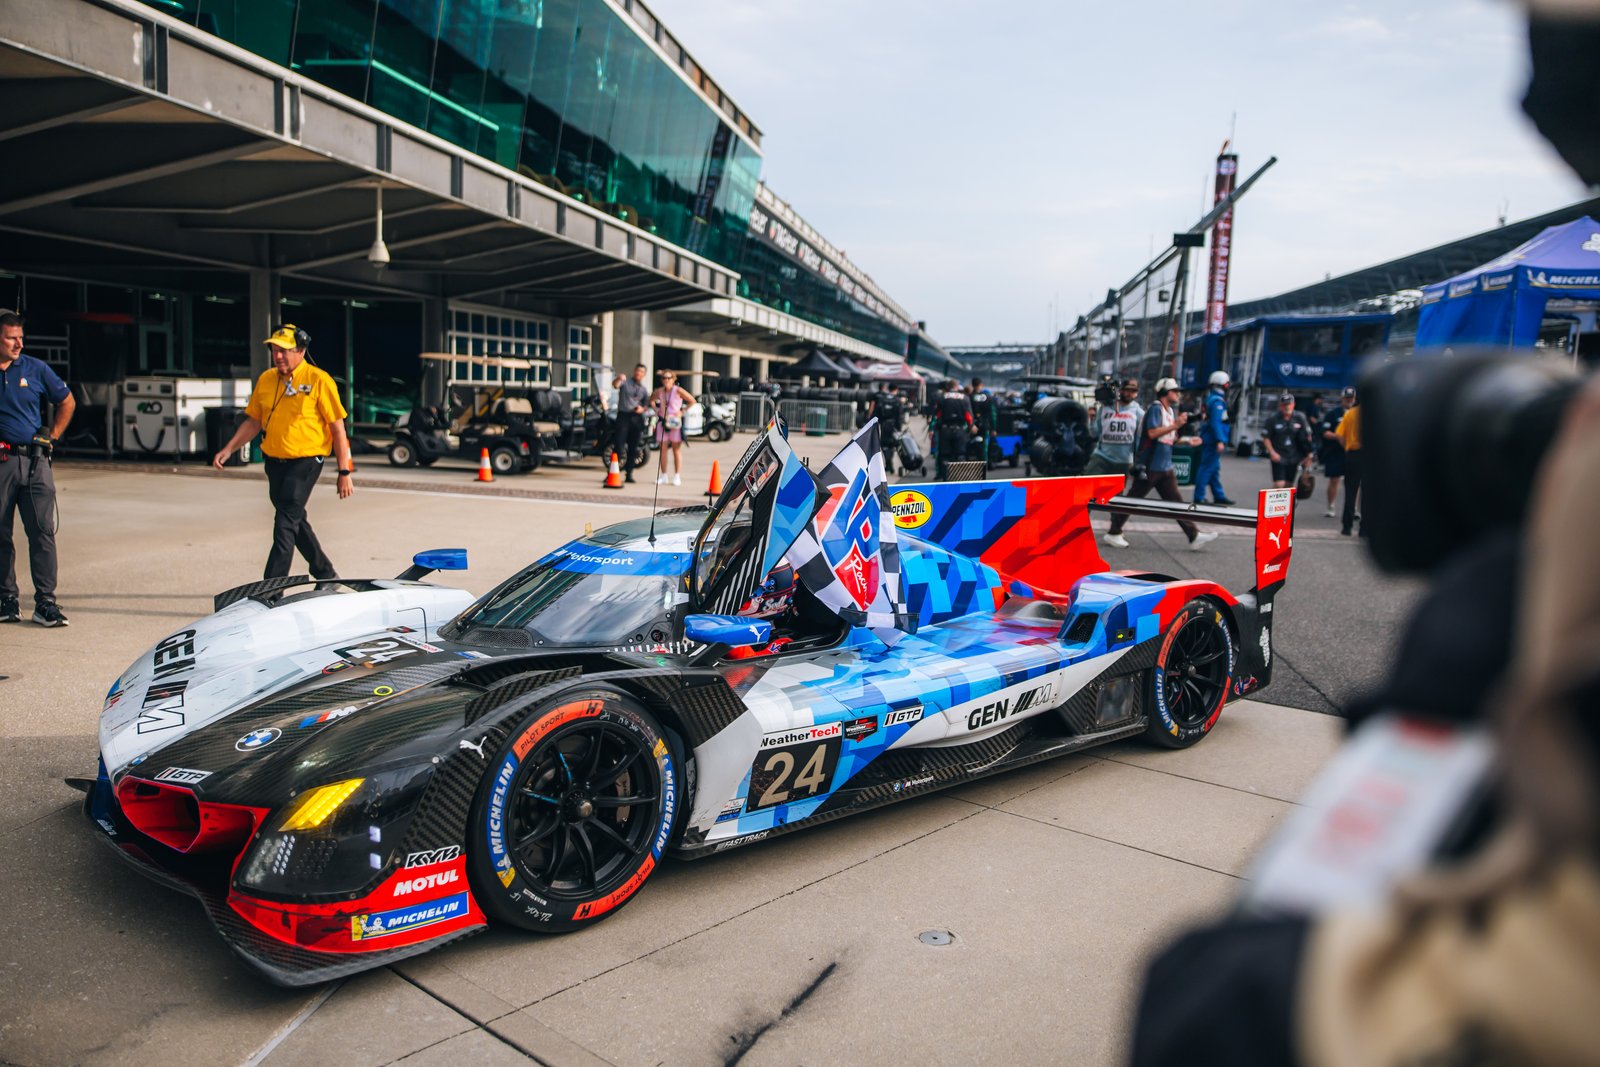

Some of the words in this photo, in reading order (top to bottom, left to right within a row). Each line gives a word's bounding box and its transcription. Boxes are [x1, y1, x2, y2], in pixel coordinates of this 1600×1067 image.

[1110, 421, 1127, 433] 610
[153, 629, 196, 682] GEN
[346, 640, 418, 665] 24
[968, 698, 1009, 731] GEN
[520, 729, 540, 752] PILOT
[541, 711, 566, 731] SPORT
[758, 744, 827, 807] 24
[490, 761, 514, 855] MICHELIN
[656, 770, 674, 852] MICHELIN
[404, 845, 461, 870] KYB
[393, 869, 459, 897] MOTUL
[387, 901, 459, 928] MICHELIN
